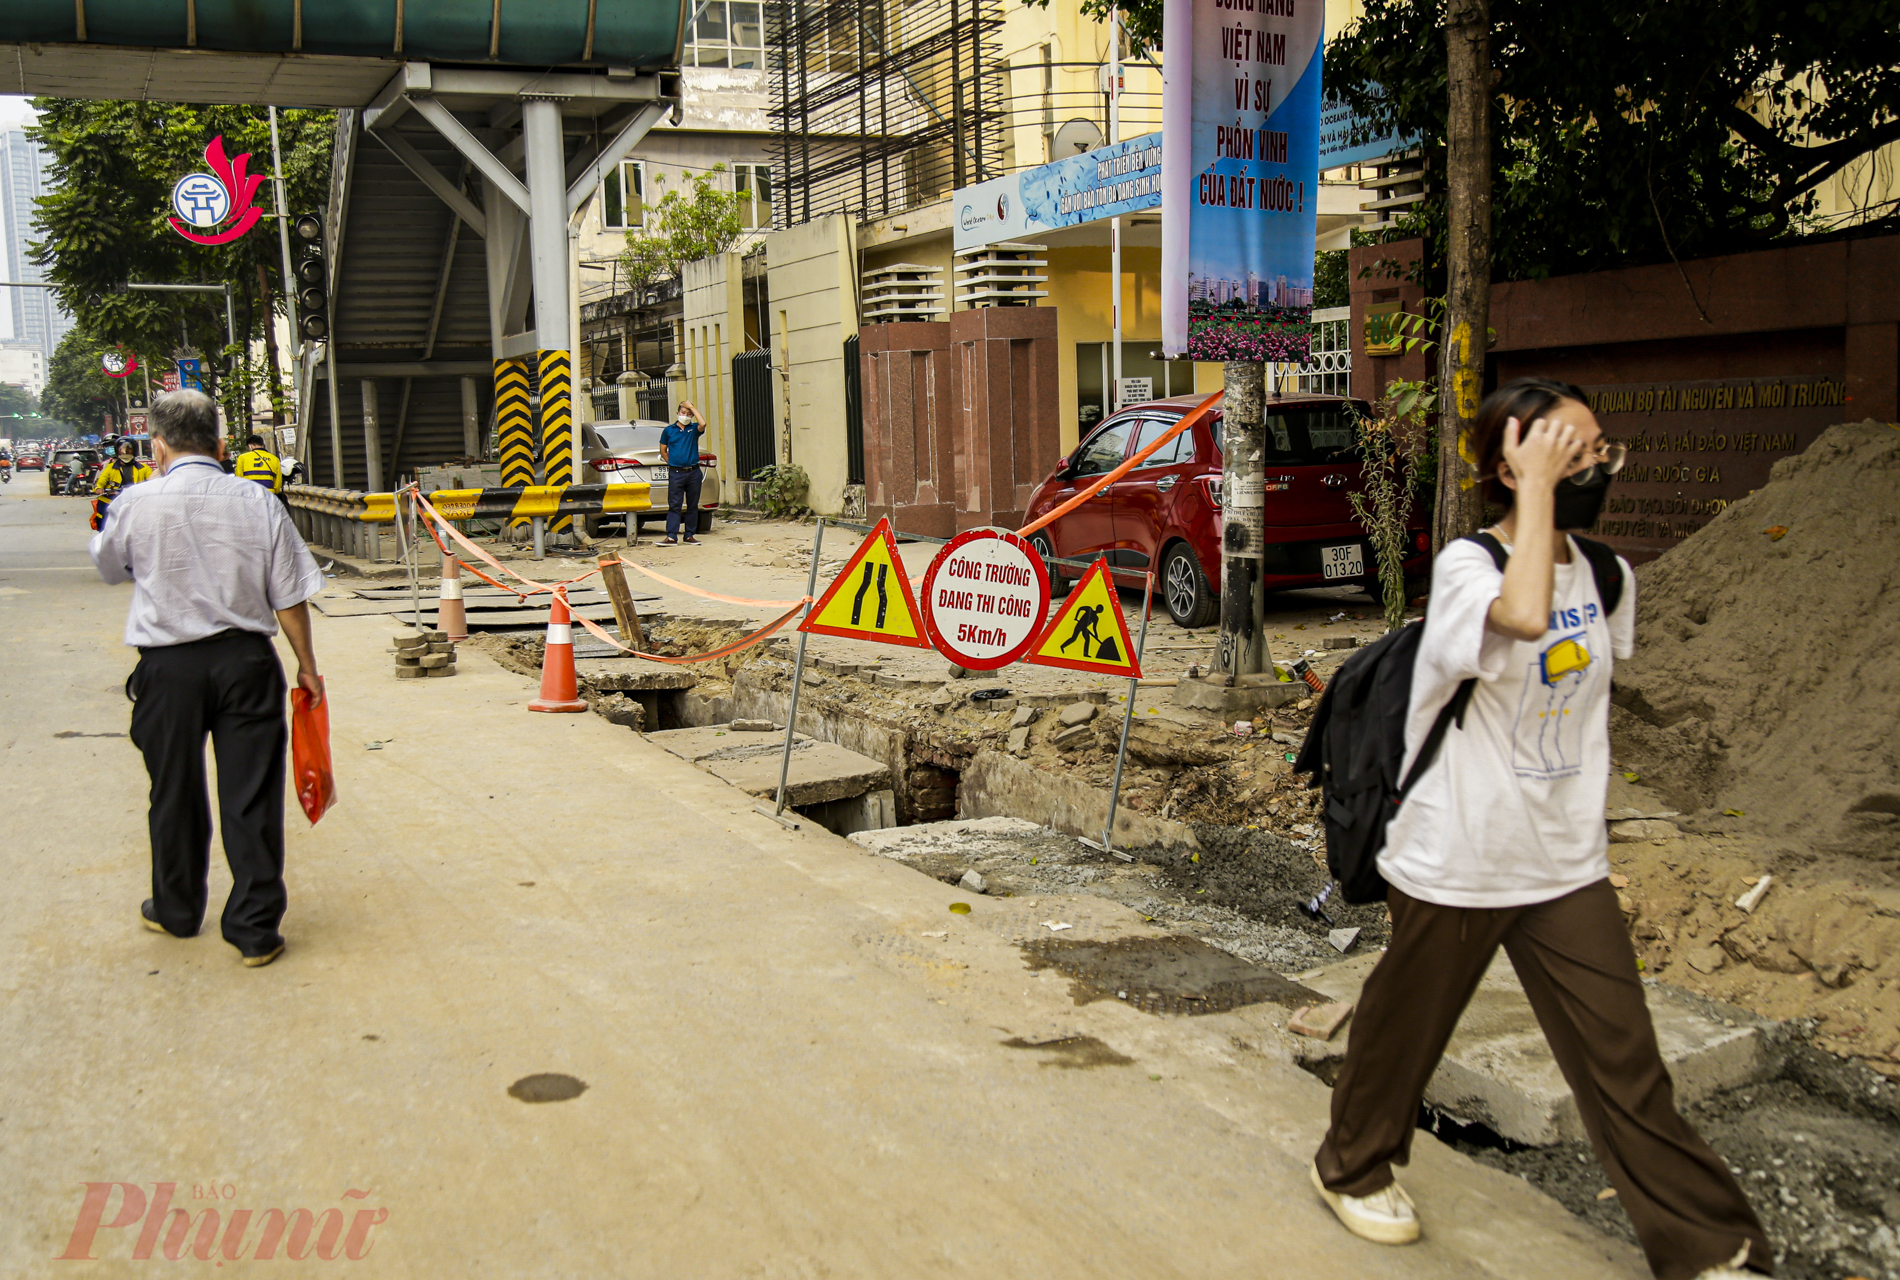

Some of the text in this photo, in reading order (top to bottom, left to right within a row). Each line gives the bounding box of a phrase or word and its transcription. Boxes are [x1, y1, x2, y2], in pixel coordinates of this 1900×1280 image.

[1222, 22, 1286, 68] VIỆT NAM
[1234, 72, 1272, 120] VÌ SỰ
[1324, 112, 1348, 126] OCEANS
[1217, 117, 1288, 164] PHỒN VINH
[1327, 130, 1337, 144] VÀ
[1097, 144, 1162, 180] PHÁT TRIỂN BỀN VỮNG
[1061, 190, 1073, 215] GẮN
[1083, 185, 1095, 209] BẢO
[1096, 181, 1107, 206] TỒN
[1108, 184, 1117, 204] ĐA
[1117, 180, 1134, 205] DẠNG
[1135, 175, 1150, 197] SINH
[1200, 163, 1226, 206] CỦA
[1230, 165, 1256, 209] ĐẤT
[1260, 174, 1294, 213] NƯỚC
[1601, 391, 1635, 415] QUAN
[1637, 386, 1655, 417] BỘ
[1657, 385, 1678, 411] TÀI
[1681, 382, 1735, 411] NGUYÊN
[1738, 380, 1755, 408] VÀ
[1759, 379, 1787, 408] MÔI
[1656, 432, 1670, 452] VÀ
[1674, 428, 1696, 452] HẢI
[1699, 427, 1728, 451] ĐẢO
[1732, 431, 1759, 455] VIỆT
[1762, 434, 1797, 452] NAM
[1653, 460, 1692, 483] QUỐC
[1695, 466, 1721, 483] GIA
[1609, 494, 1635, 514] ĐÀO
[1602, 518, 1654, 538] NGUYÊN
[1657, 519, 1673, 538] VÀ
[1331, 546, 1352, 561] 30F
[949, 556, 1031, 587] CÔNG TRƯỜNG
[1325, 560, 1363, 578] 013.20
[938, 589, 1031, 618] ĐANG THI CÔNG
[957, 623, 1007, 647] 5Km/h
